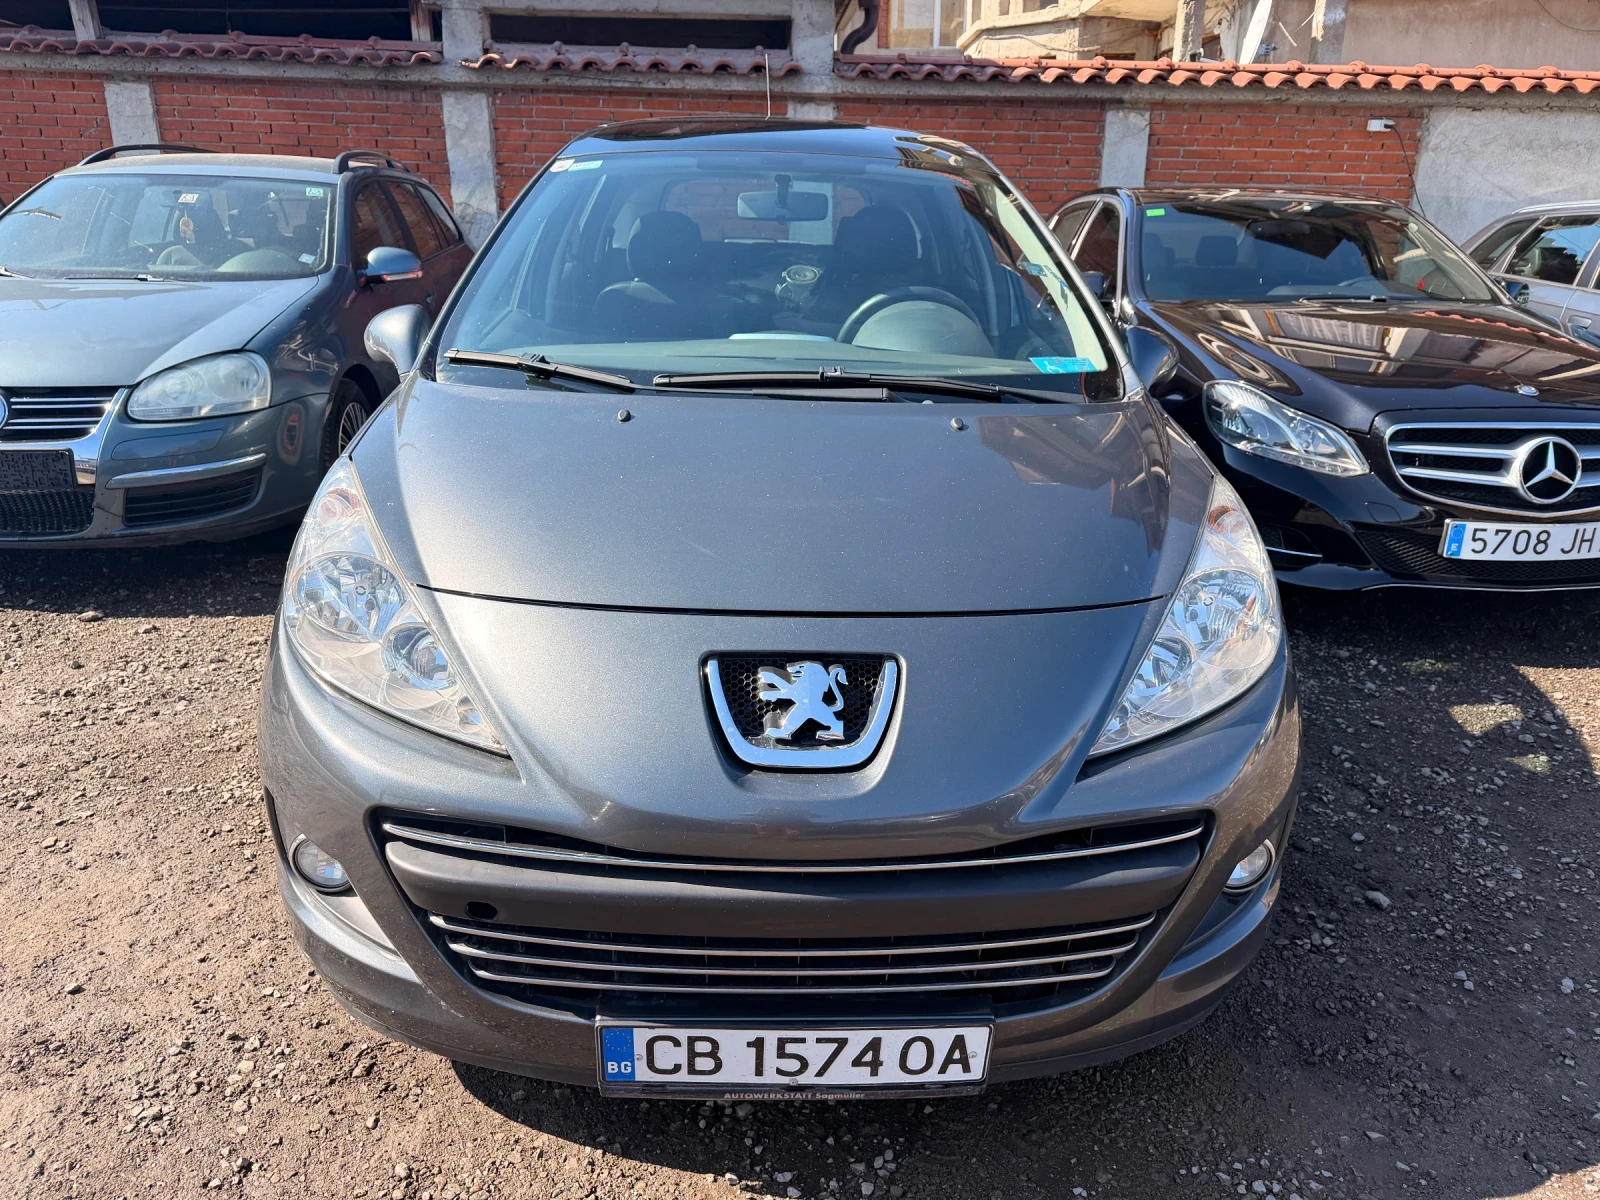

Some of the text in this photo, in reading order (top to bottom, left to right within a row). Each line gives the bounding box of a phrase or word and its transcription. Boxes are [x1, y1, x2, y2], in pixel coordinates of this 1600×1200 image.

[1450, 543, 1459, 551] E
[1470, 527, 1600, 555] 5708 JH
[645, 1034, 973, 1077] CB 1574 OA
[607, 1061, 632, 1074] BG
[723, 1091, 812, 1100] AUTOWERKSTATT
